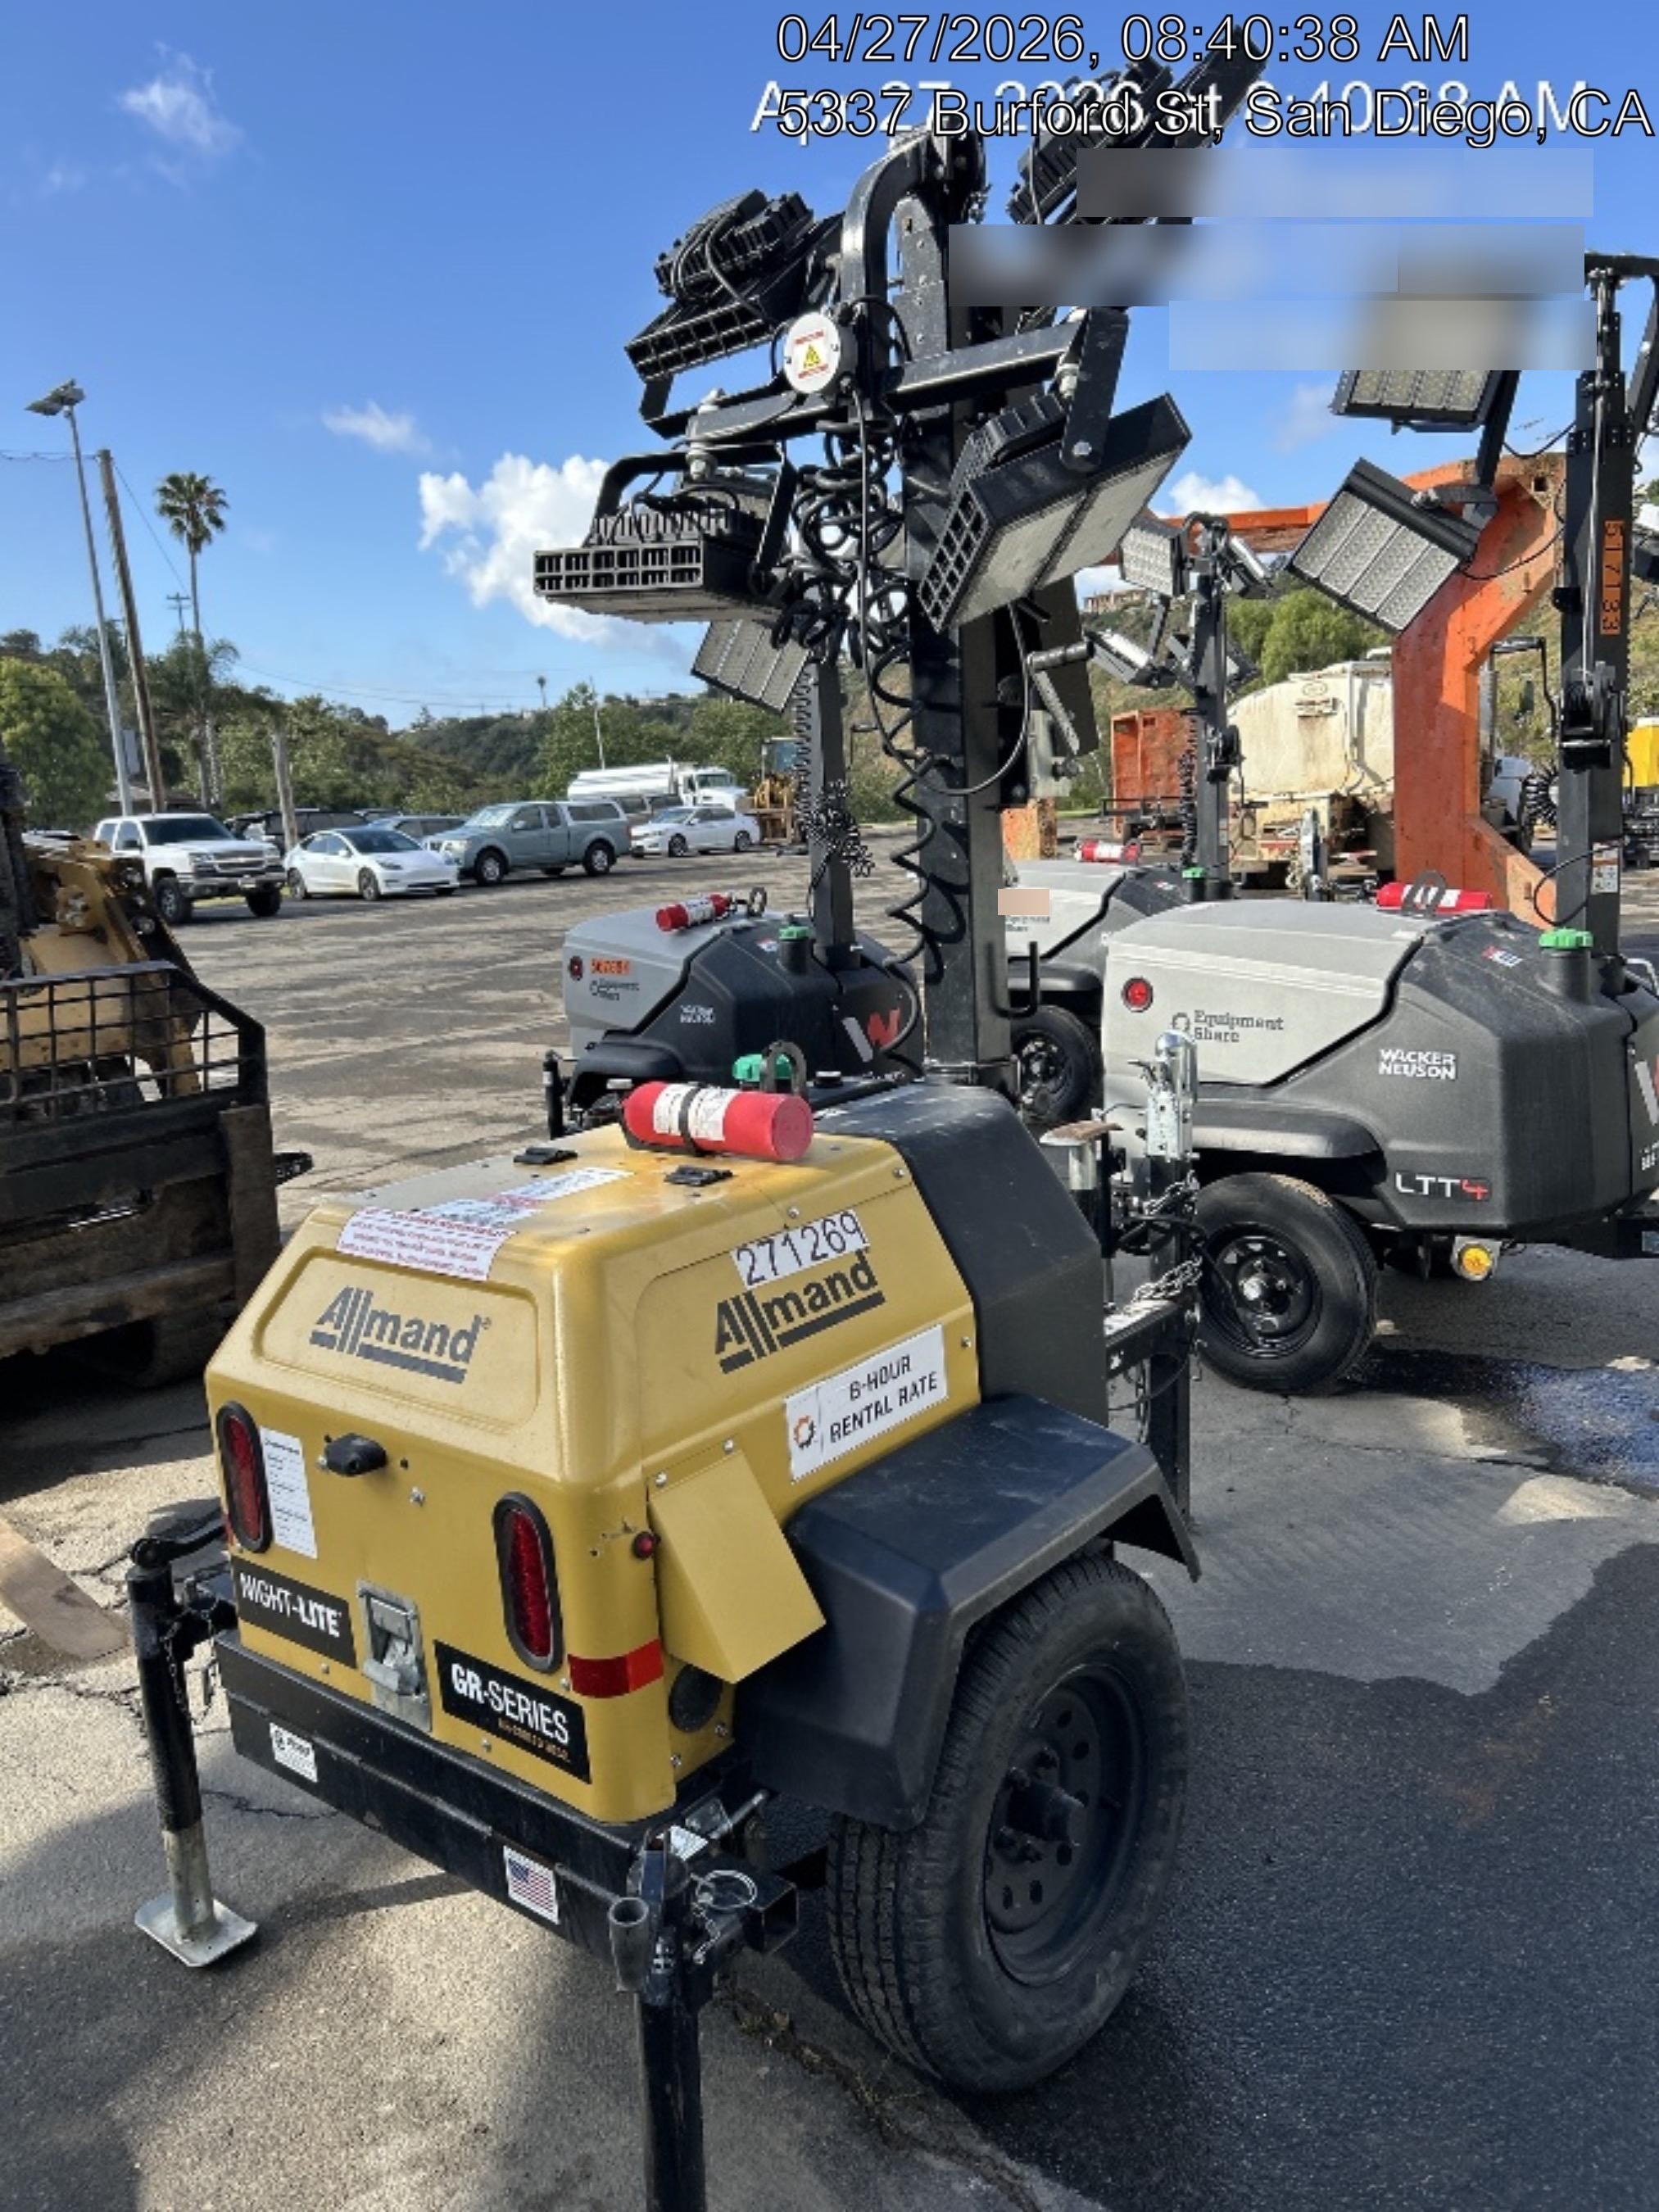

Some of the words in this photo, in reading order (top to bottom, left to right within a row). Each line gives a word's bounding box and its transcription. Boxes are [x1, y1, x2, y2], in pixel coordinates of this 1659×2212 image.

[1194, 1009, 1284, 1030] Equipment
[1194, 1027, 1240, 1042] Share
[1379, 1049, 1456, 1065] WACKER
[1378, 1062, 1457, 1081] NEUSON
[1395, 1172, 1488, 1200] LTT4
[737, 1213, 867, 1285] 271269
[715, 1247, 879, 1360] Allmand
[830, 1396, 893, 1444] RENTAL
[899, 1371, 938, 1407] RATE
[451, 1663, 569, 1745] GR-SERIES
